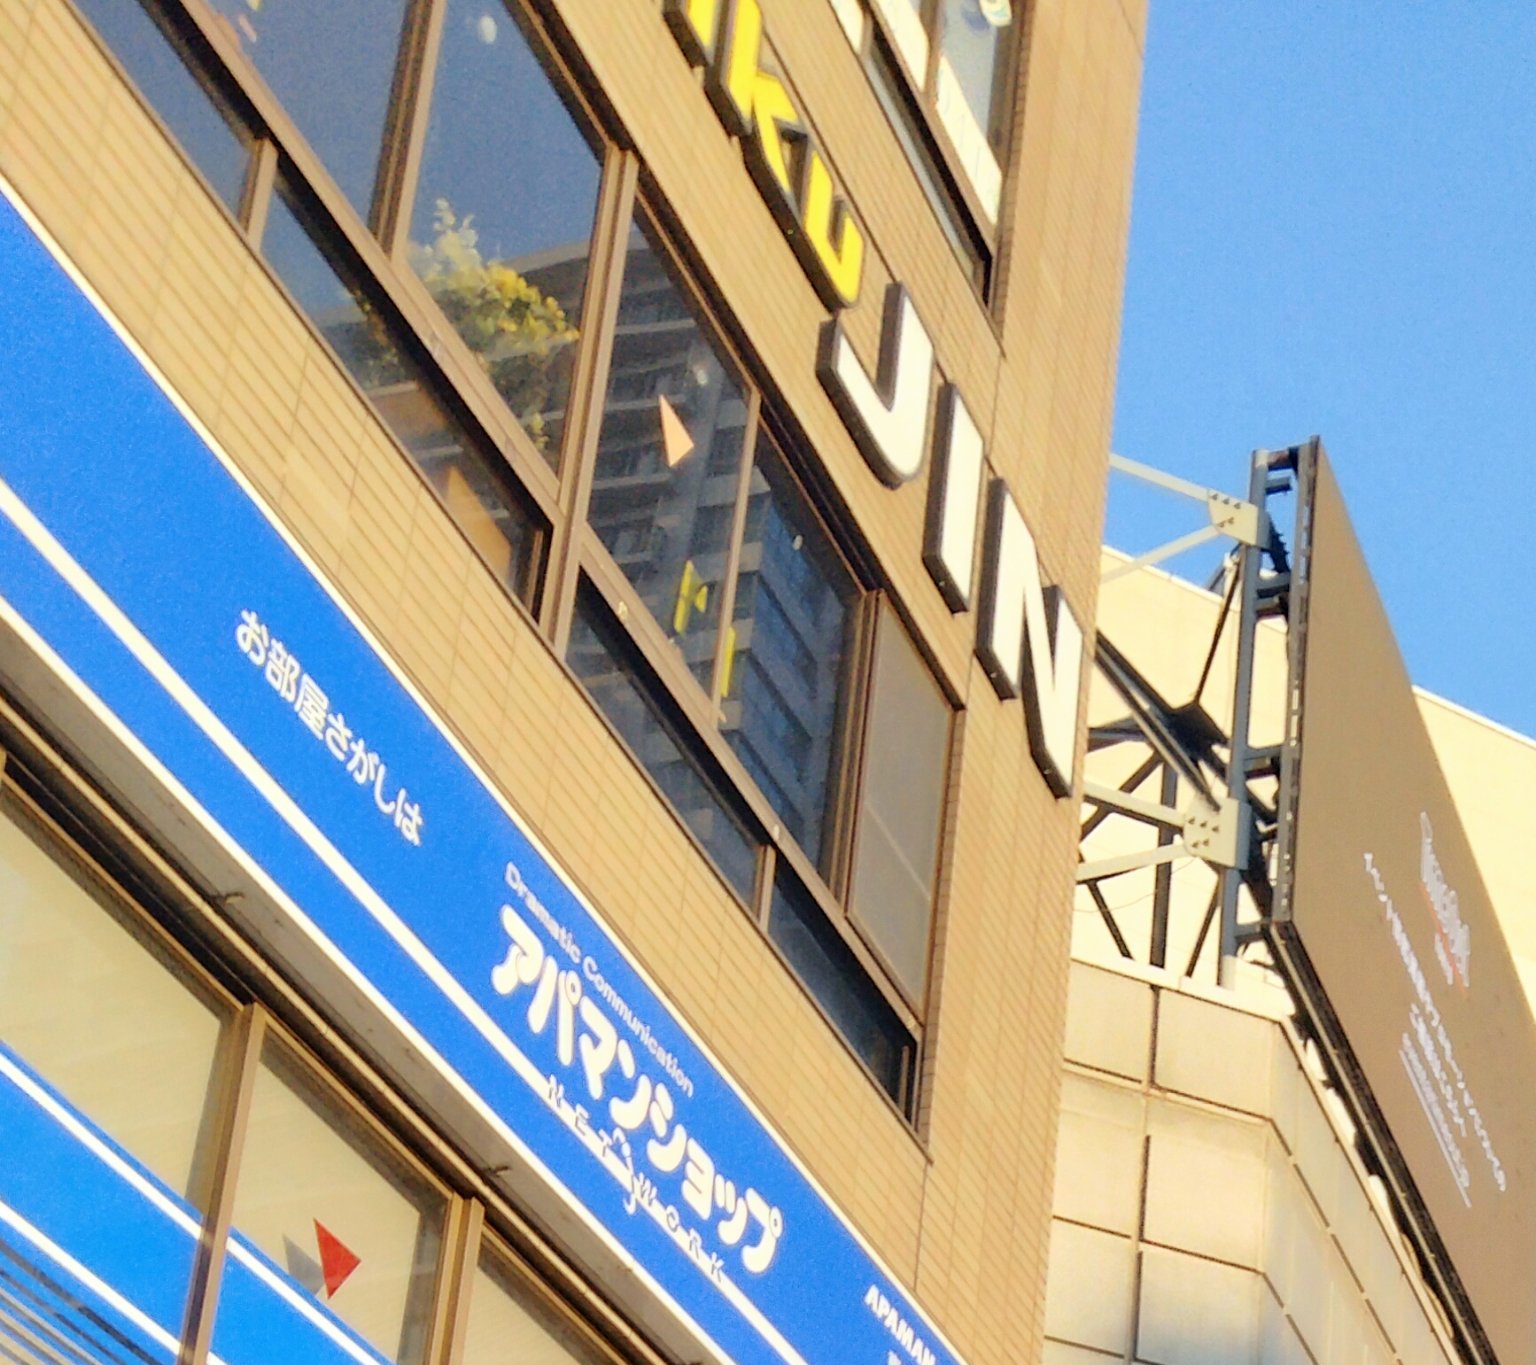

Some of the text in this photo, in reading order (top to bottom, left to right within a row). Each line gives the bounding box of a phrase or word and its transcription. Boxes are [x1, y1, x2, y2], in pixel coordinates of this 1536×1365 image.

[815, 280, 1083, 798] JIN
[235, 608, 424, 847] お部屋さがしは
[491, 904, 784, 1275] アパマンショップ
[505, 861, 695, 1099] Dramatic Communication
